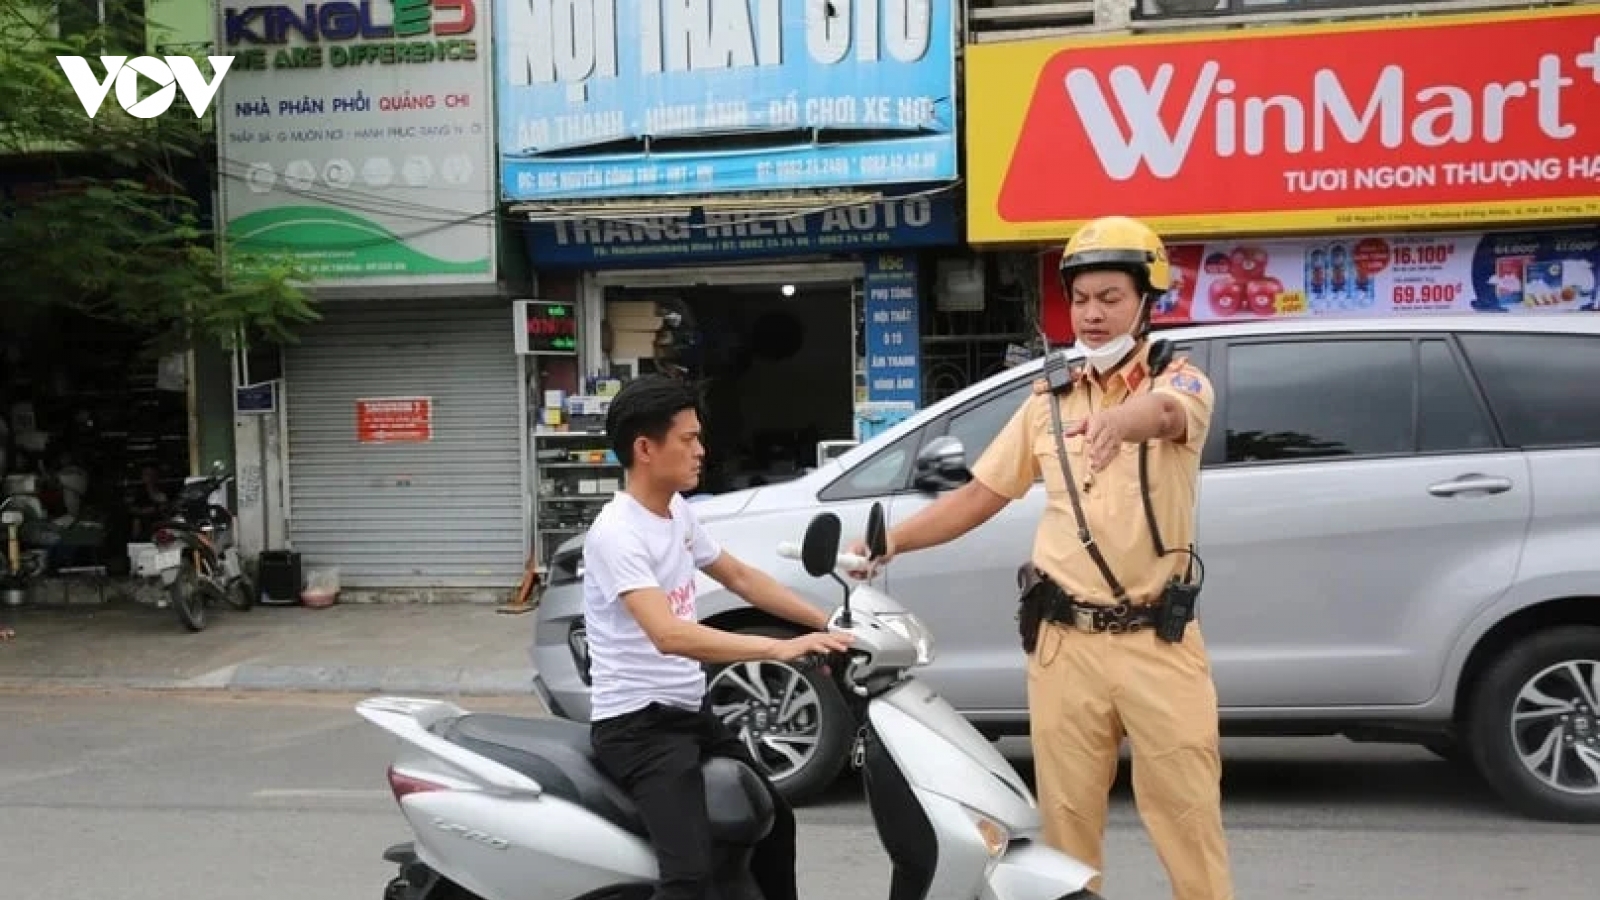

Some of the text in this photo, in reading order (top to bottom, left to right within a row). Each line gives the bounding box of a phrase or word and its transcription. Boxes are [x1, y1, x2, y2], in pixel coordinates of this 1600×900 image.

[274, 47, 323, 69] ARE
[329, 39, 477, 68] DIFFERENCE
[235, 95, 271, 117] NHÀ
[806, 94, 856, 124] CHƠI
[863, 94, 891, 123] XE
[1354, 164, 1436, 190] NGON
[1442, 157, 1562, 187] THƯỢNG
